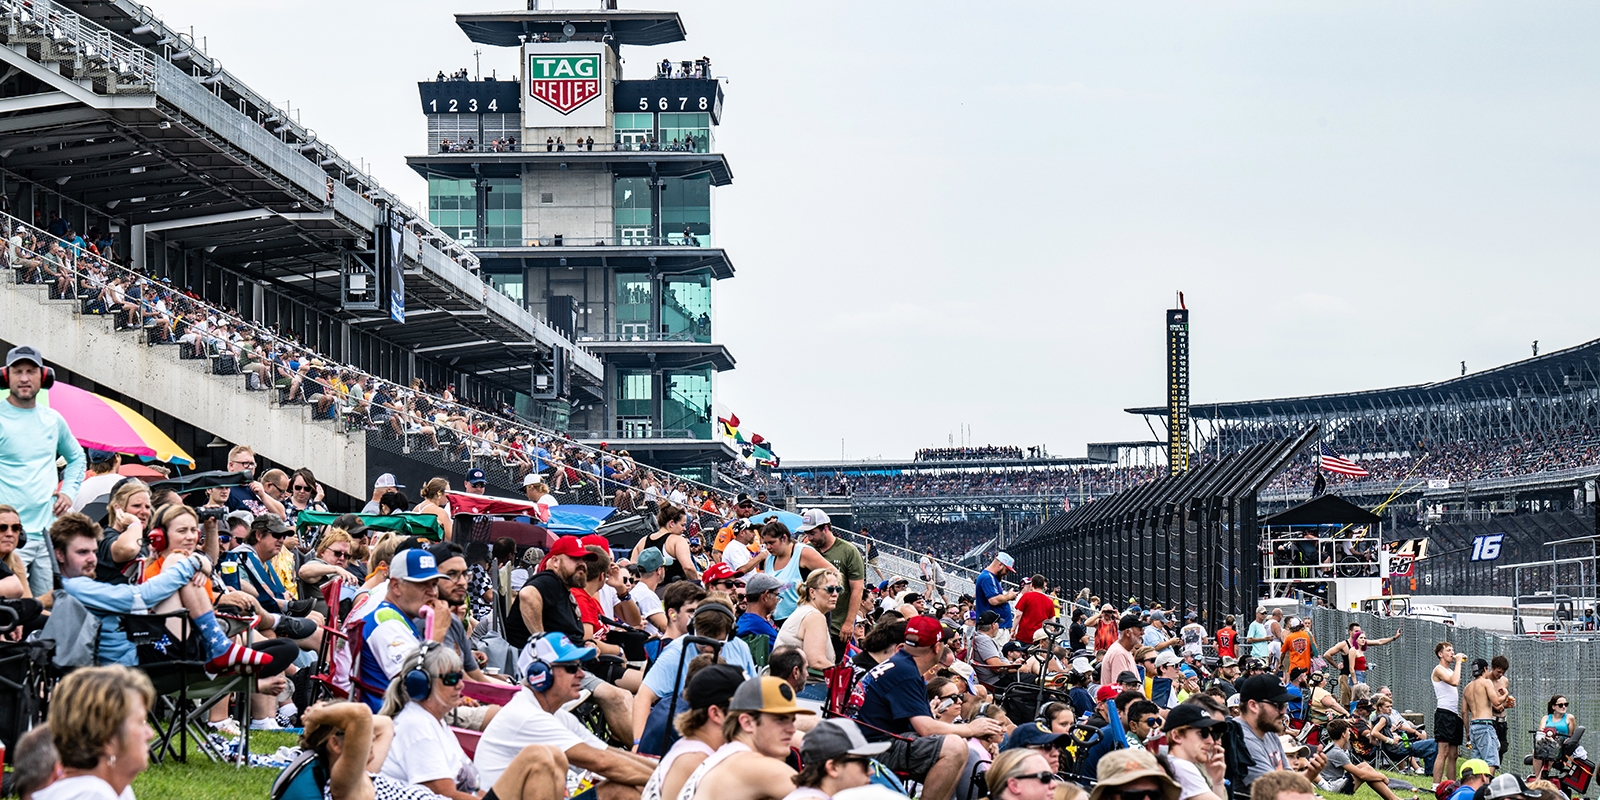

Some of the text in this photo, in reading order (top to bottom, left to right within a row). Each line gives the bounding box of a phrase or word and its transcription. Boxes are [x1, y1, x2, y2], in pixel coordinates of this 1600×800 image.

[536, 59, 594, 77] TAG
[535, 81, 597, 108] HEUER
[430, 99, 497, 111] 1 2 3 4
[640, 97, 707, 110] 5 6 7 8
[575, 538, 583, 548] P
[1397, 537, 1429, 561] 41
[1471, 534, 1504, 561] 16
[1426, 575, 1431, 583] 3
[1220, 636, 1230, 647] 12
